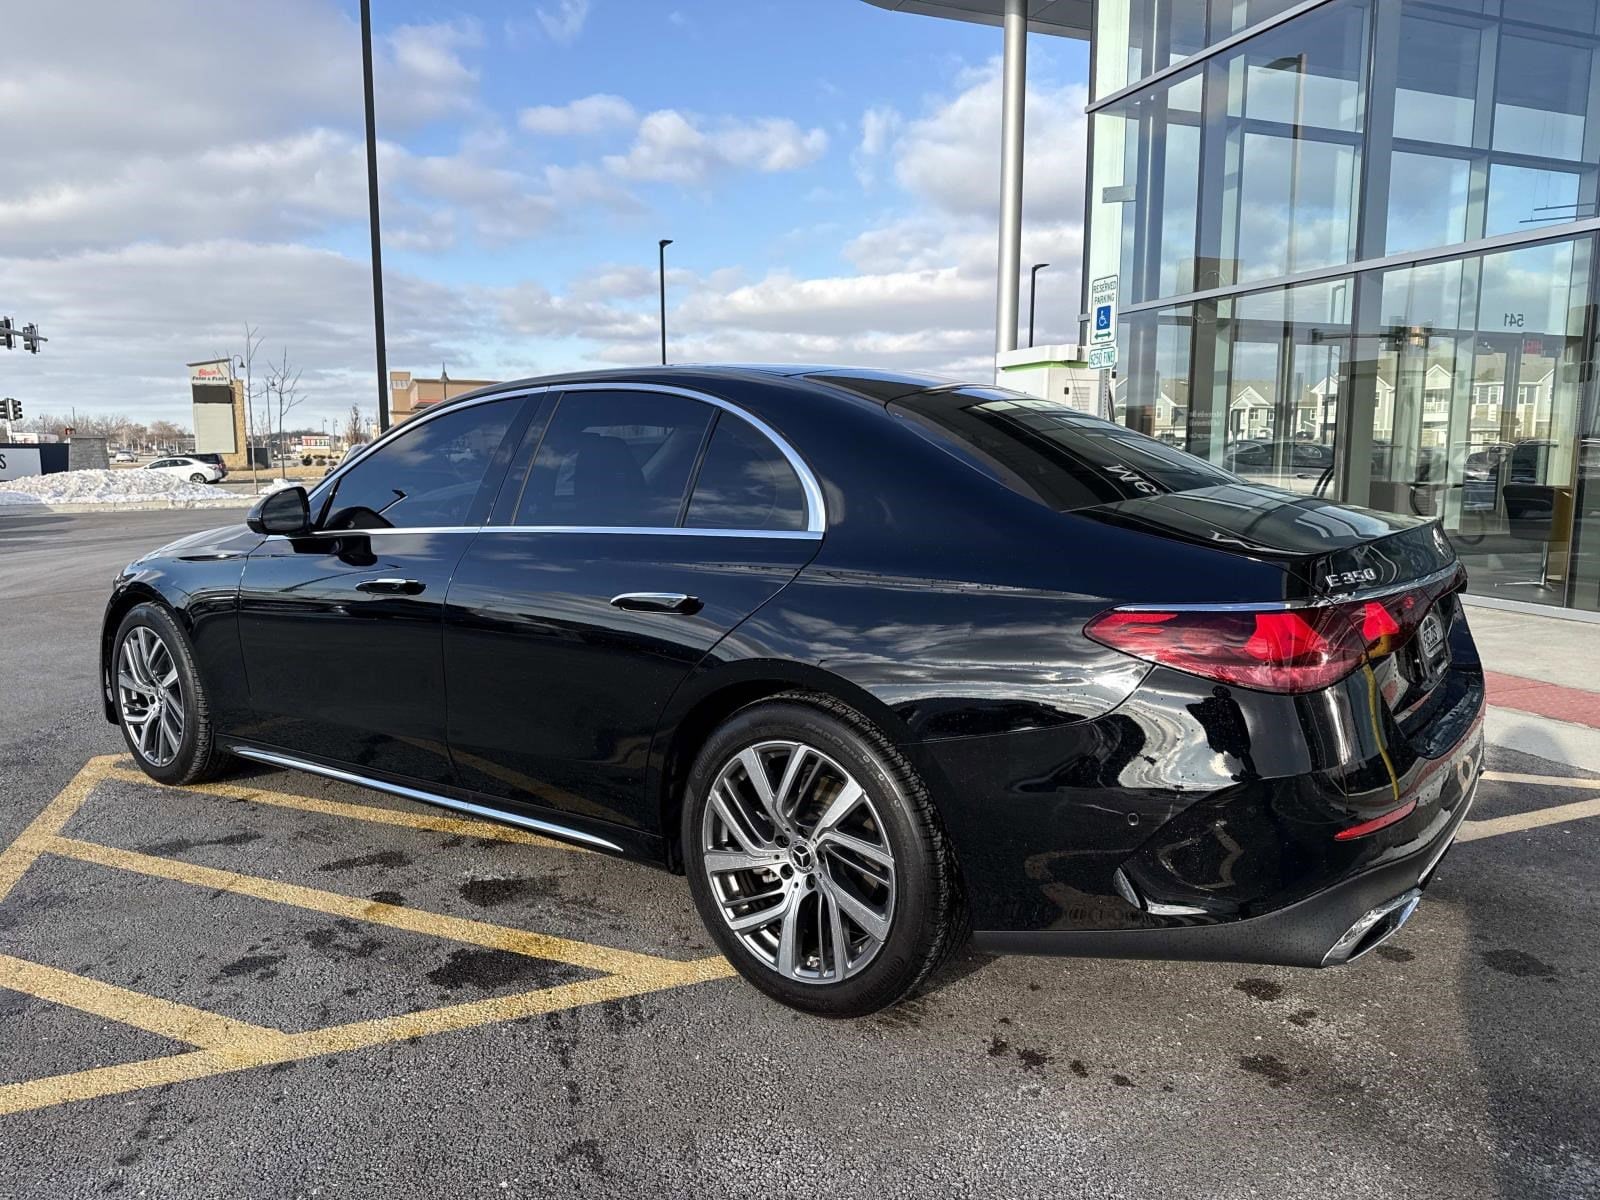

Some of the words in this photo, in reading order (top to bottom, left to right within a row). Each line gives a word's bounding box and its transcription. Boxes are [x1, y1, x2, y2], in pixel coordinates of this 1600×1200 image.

[1093, 281, 1117, 293] RESERVED
[1094, 293, 1115, 305] PARKING
[1103, 351, 1114, 364] FINE
